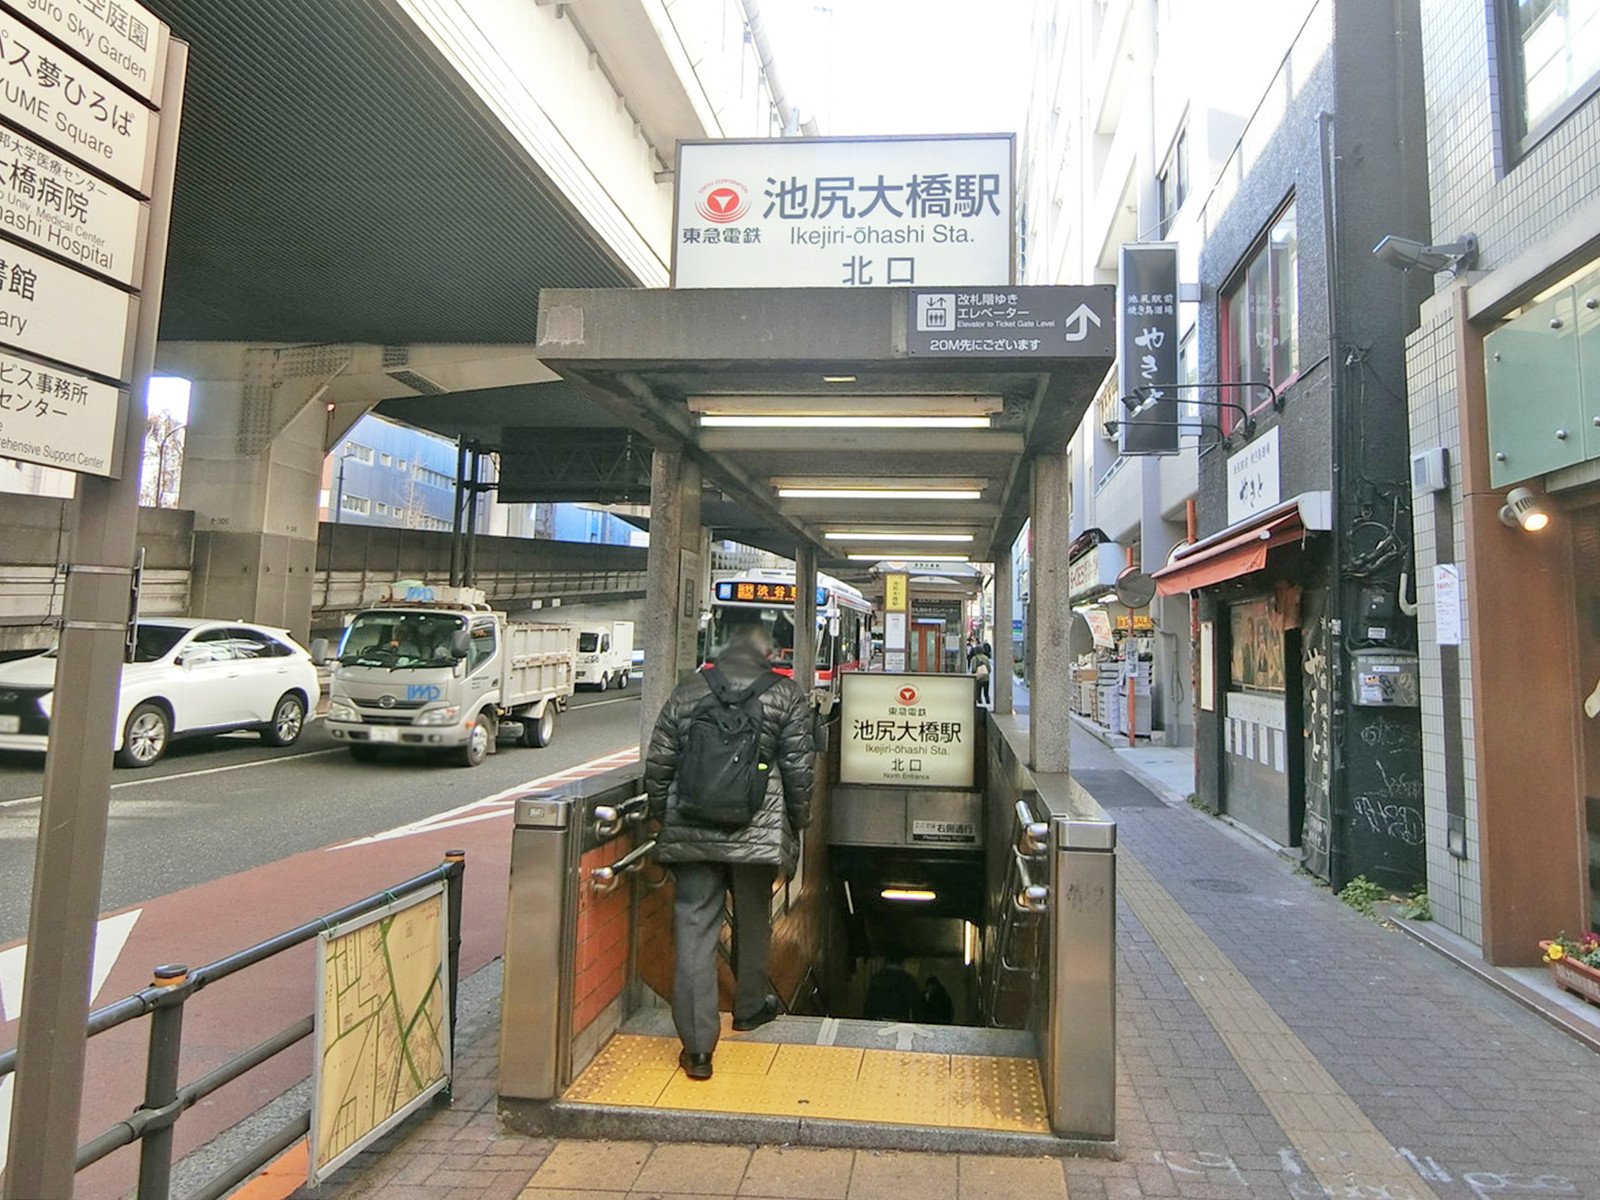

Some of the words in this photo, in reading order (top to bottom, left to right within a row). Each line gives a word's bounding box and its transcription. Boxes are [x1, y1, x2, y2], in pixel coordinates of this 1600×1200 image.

[67, 12, 95, 47] Sky
[98, 35, 147, 82] Garden
[0, 78, 49, 123] UME
[55, 112, 114, 159] Square
[762, 174, 1000, 220] 池尻大橋駅
[36, 206, 73, 233] Medical
[75, 225, 105, 247] Center
[682, 227, 762, 244] 東急電鉄
[791, 224, 925, 250] Ikejiri-ōhashi
[932, 224, 974, 244] Sta.
[48, 224, 113, 270] Hospital
[842, 256, 915, 286] 北口
[957, 294, 1018, 306] 改札階ゆき
[957, 307, 1029, 319] エレベーター
[957, 320, 986, 328] Elevator
[995, 320, 1016, 328] Ticket
[1017, 320, 1035, 328] Gate
[1036, 320, 1055, 328] Level
[930, 339, 1041, 351] 20M先にございます
[0, 361, 88, 406] ビス事務所
[0, 388, 67, 418] センター
[0, 436, 41, 456] ehensive
[43, 444, 76, 464] Support
[77, 452, 104, 469] Center
[888, 707, 927, 717] 東急電鉄
[853, 720, 961, 743] 池尻大橋駅
[930, 745, 950, 756] Sta.
[883, 772, 901, 780] North
[902, 772, 930, 780] Entrance
[891, 758, 922, 772] 北口
